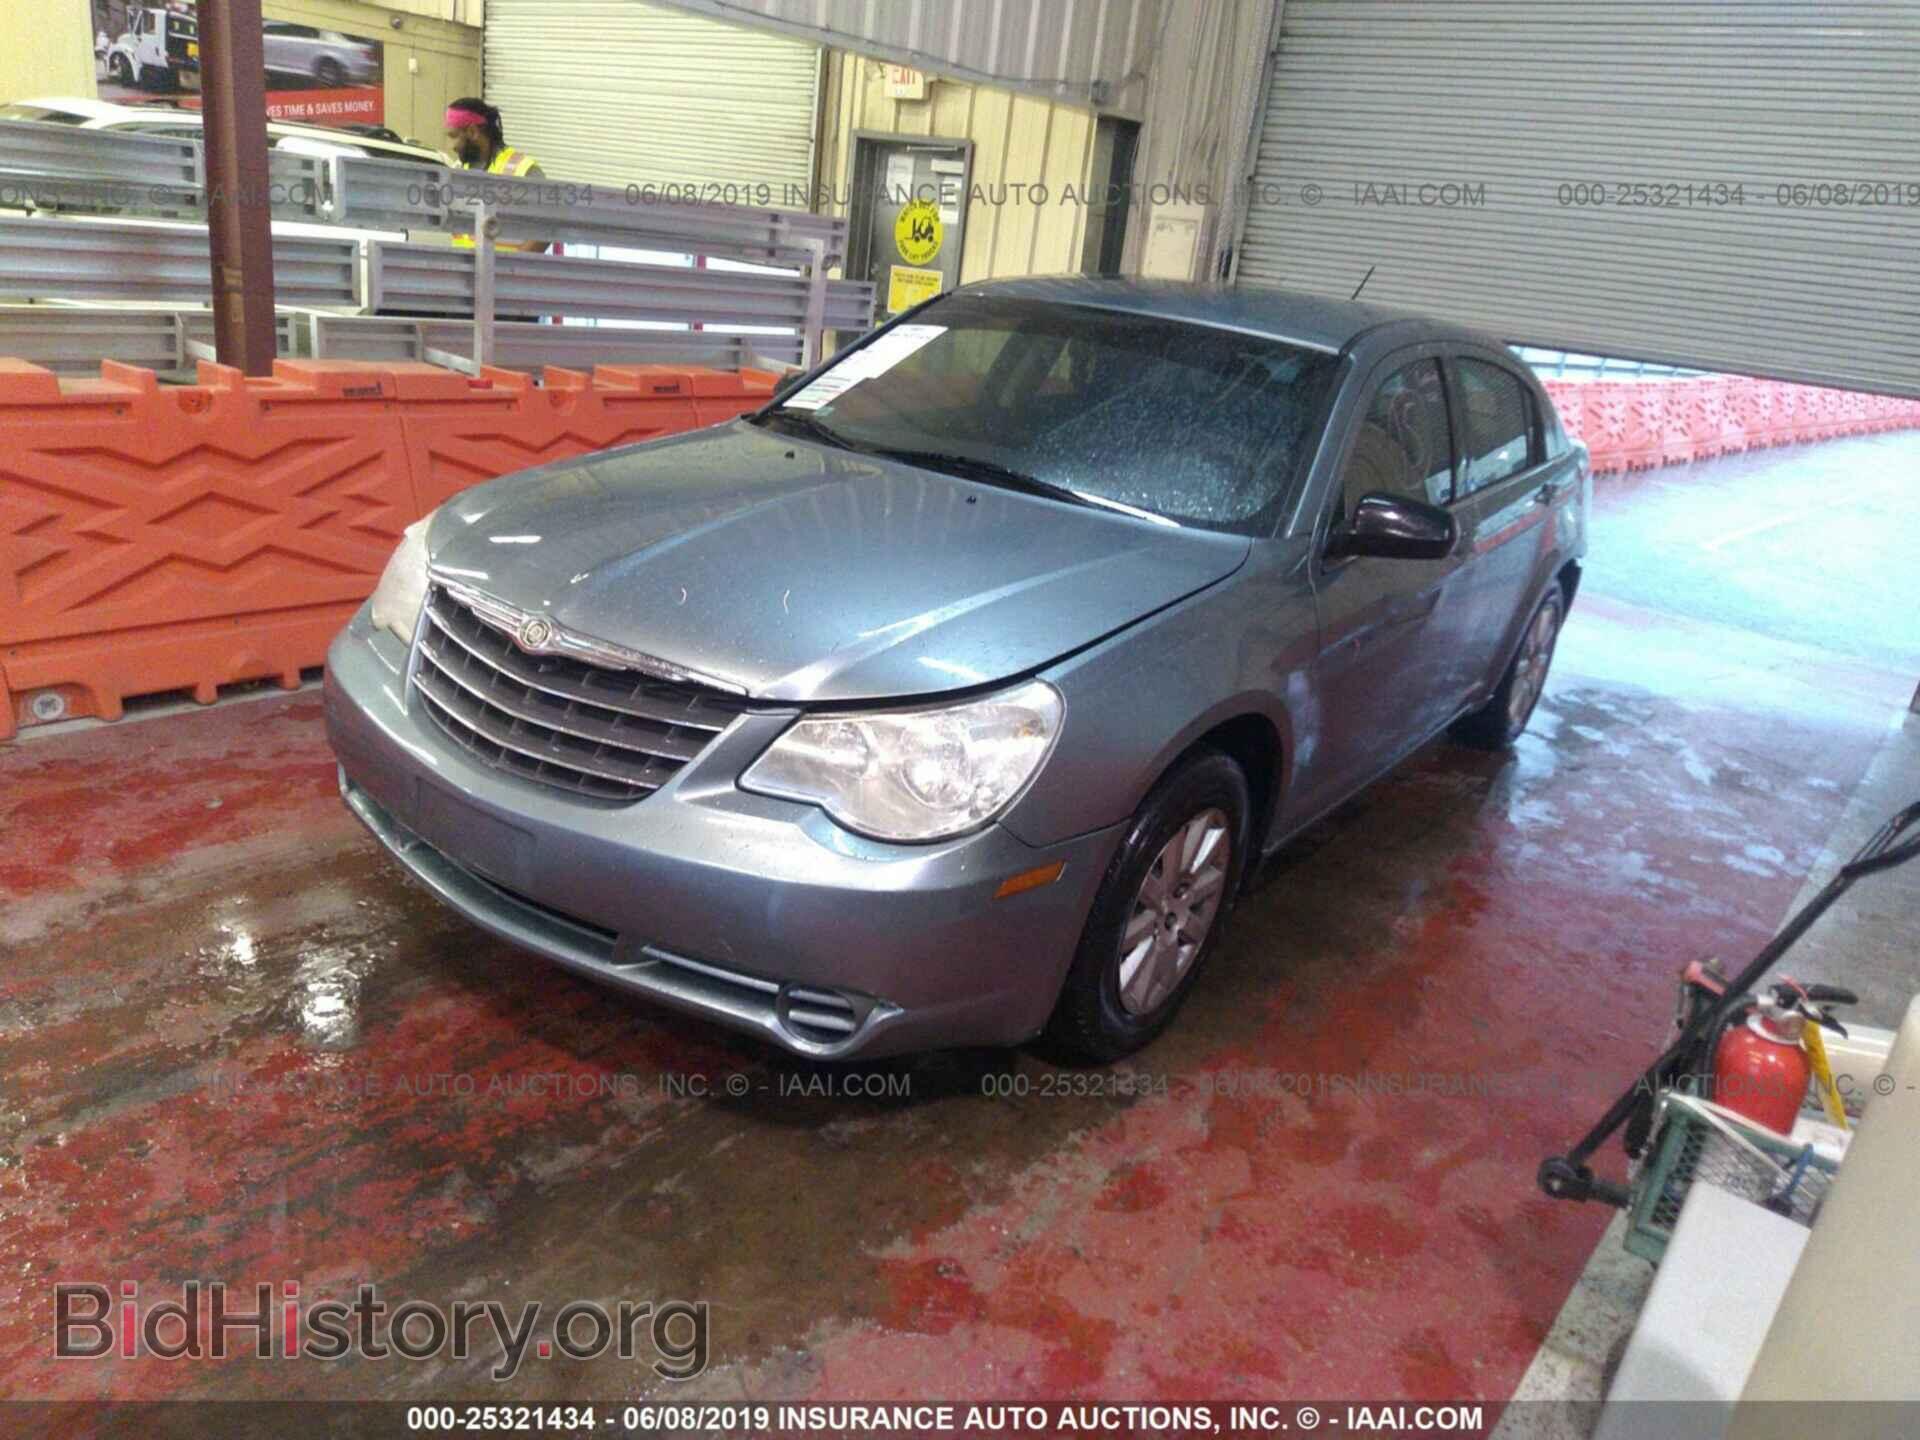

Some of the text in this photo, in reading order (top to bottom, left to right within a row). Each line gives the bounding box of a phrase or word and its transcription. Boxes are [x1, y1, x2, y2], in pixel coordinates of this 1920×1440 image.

[283, 104, 305, 115] TIME
[307, 103, 314, 115] &
[315, 102, 343, 114] SAVES
